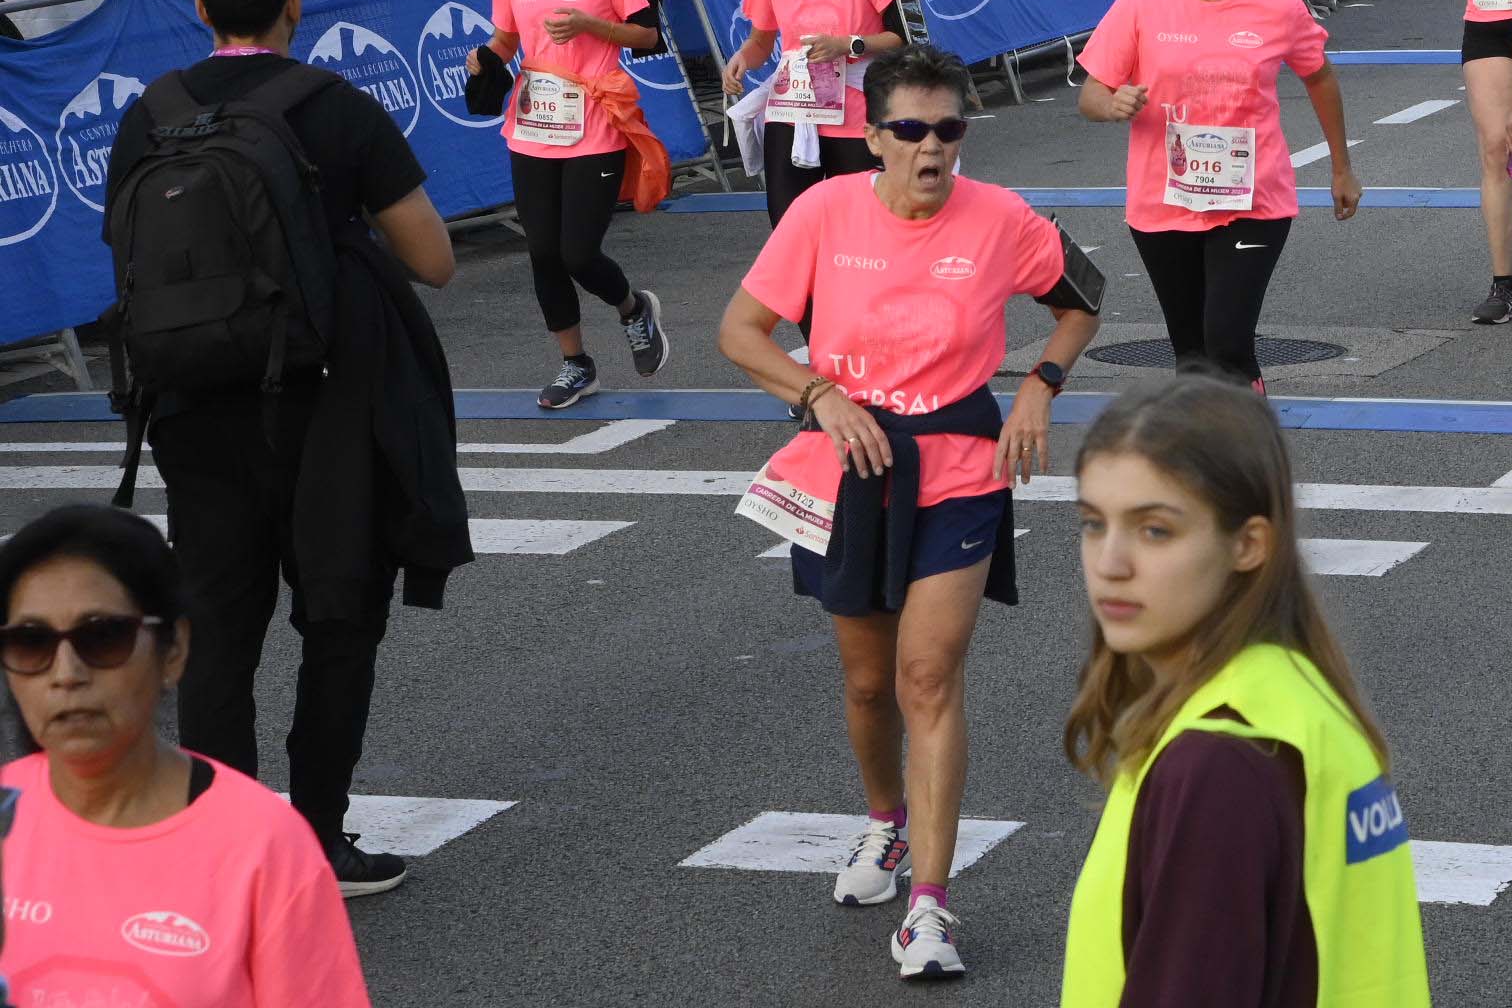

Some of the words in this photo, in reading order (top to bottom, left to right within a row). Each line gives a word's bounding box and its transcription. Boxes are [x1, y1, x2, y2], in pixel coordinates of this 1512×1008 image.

[1158, 32, 1198, 43] OYSHO
[363, 59, 400, 77] LECHERA
[533, 100, 557, 112] 016
[1160, 103, 1188, 123] TU
[1189, 159, 1222, 173] 016
[1194, 175, 1215, 184] 7904
[833, 253, 888, 272] OYSHO
[828, 352, 866, 380] TU
[744, 498, 778, 521] OYSHO
[755, 486, 786, 507] CARRERA
[785, 503, 796, 512] DE
[796, 508, 805, 519] LA
